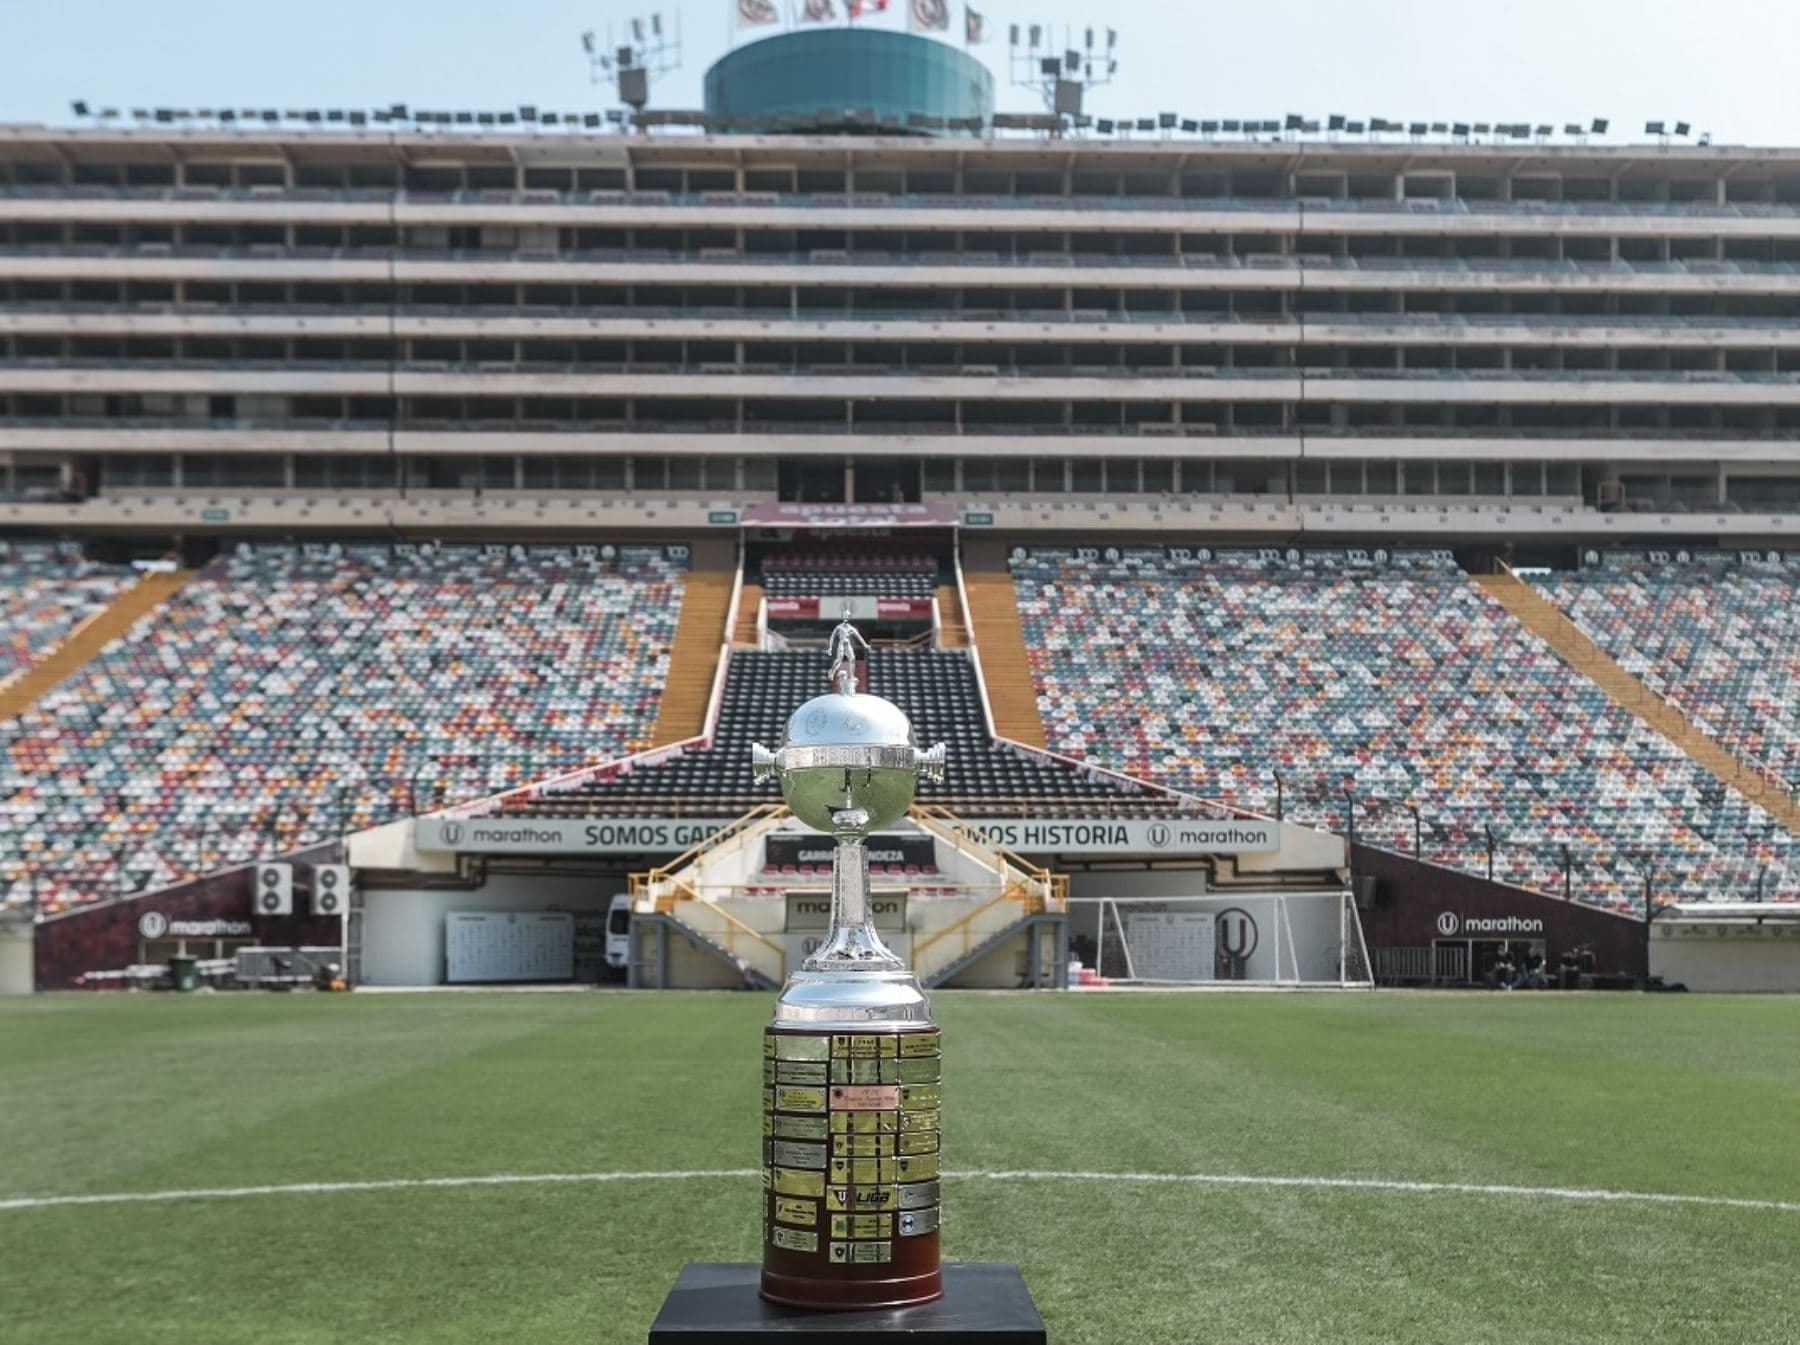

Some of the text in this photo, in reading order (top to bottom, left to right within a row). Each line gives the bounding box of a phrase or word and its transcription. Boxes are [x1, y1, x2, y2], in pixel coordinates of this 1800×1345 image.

[474, 829, 562, 843] marathon
[585, 825, 668, 845] SOMOS
[1024, 825, 1129, 845] HISTORIA
[1180, 829, 1267, 844] marathon
[798, 902, 898, 913] maon
[1466, 916, 1543, 932] marathon
